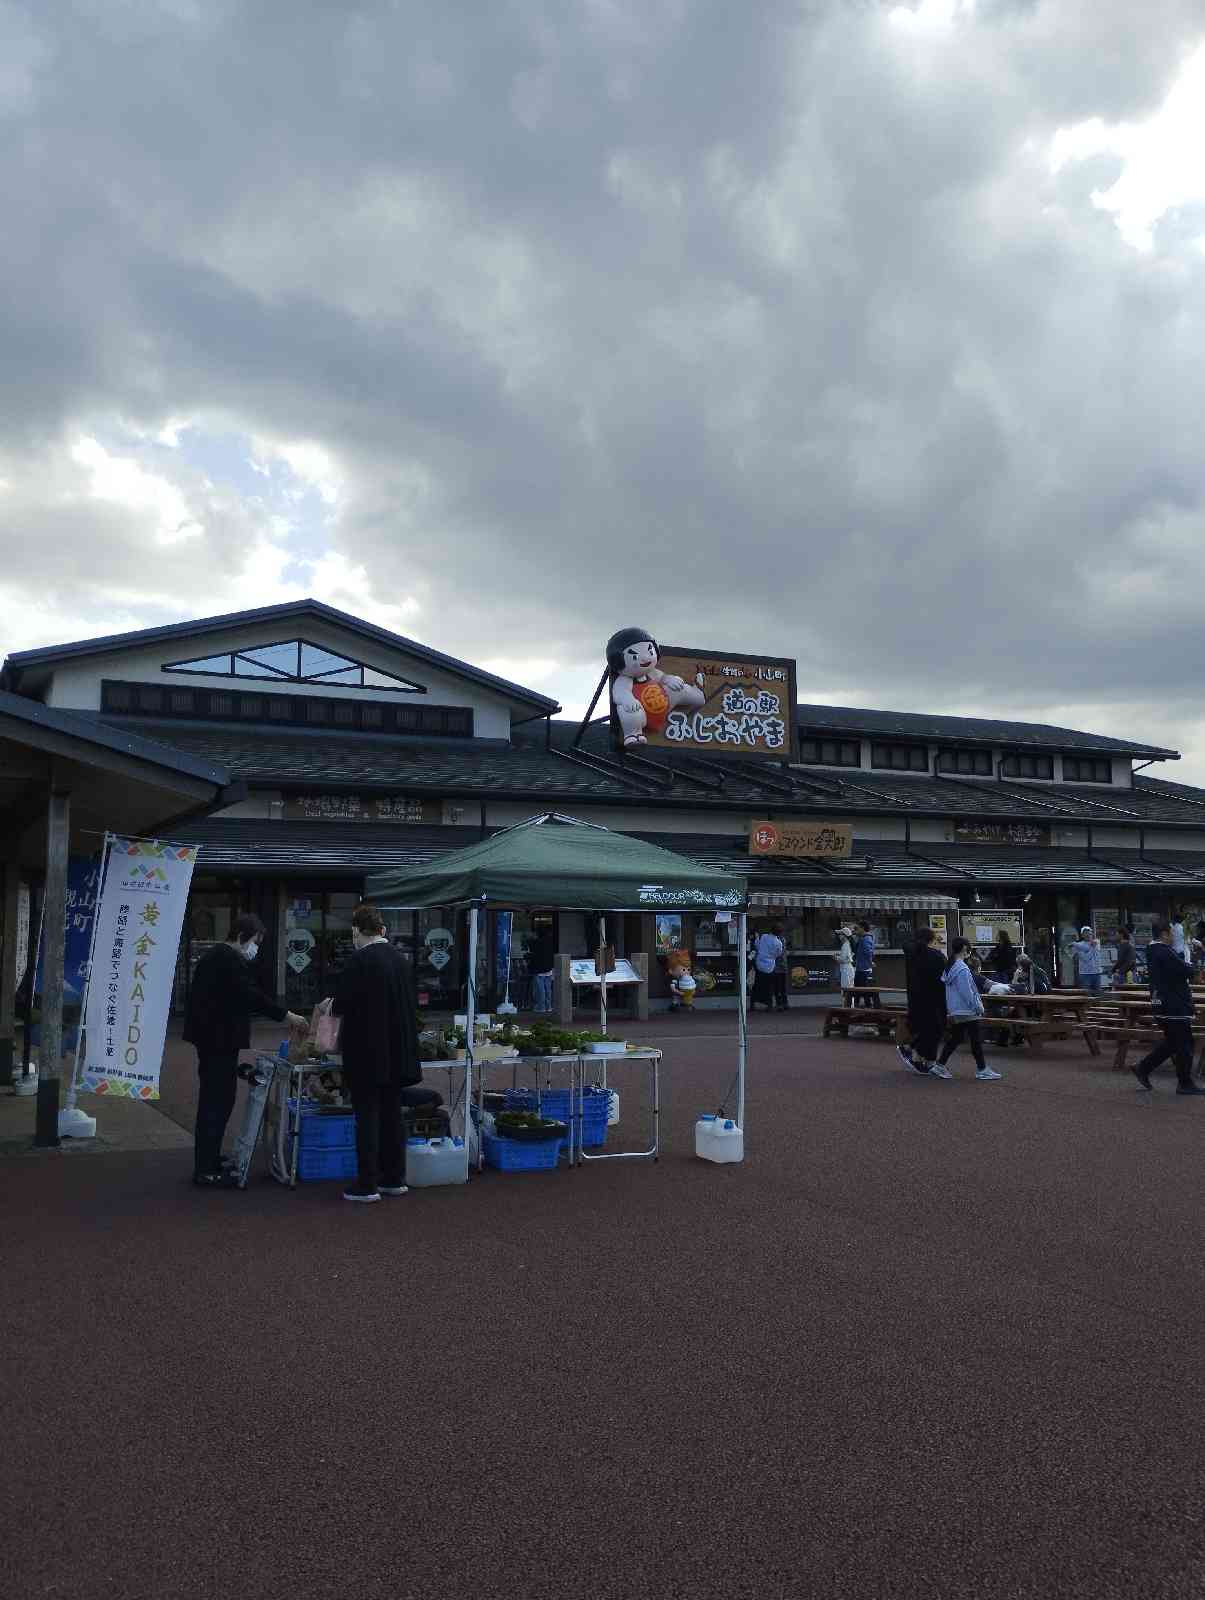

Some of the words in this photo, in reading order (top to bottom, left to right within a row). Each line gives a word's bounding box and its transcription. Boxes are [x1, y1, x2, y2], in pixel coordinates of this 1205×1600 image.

[723, 688, 779, 715] 道の駅
[666, 711, 784, 748] ふじおやま
[125, 901, 161, 1066] 黄金KAIDO
